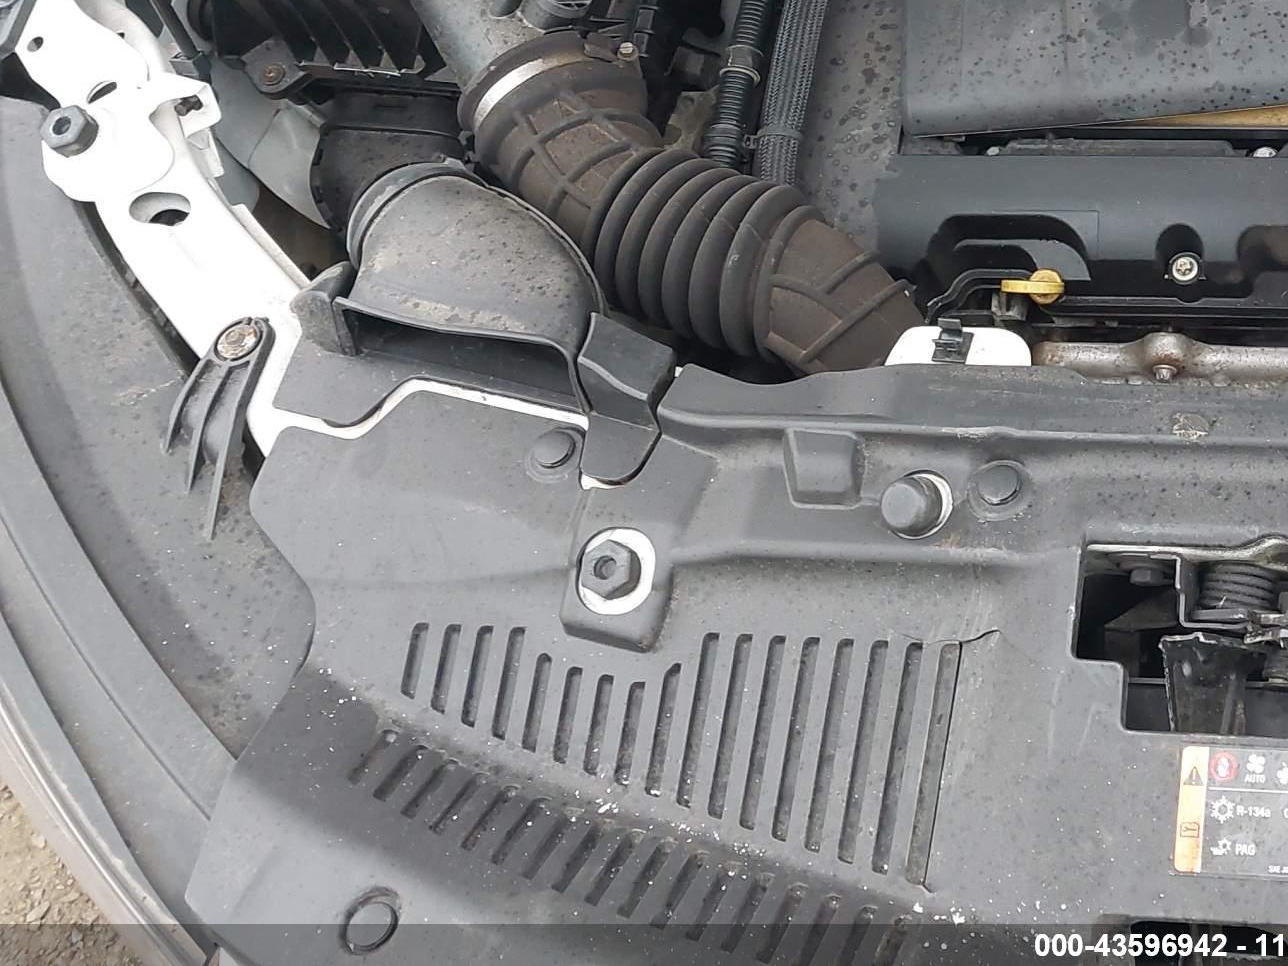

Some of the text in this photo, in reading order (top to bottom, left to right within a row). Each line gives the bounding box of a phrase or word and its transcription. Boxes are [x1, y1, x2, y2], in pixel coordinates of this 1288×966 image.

[1244, 774, 1266, 783] AUTO
[1236, 805, 1271, 818] R-134a
[1235, 844, 1256, 855] PAG
